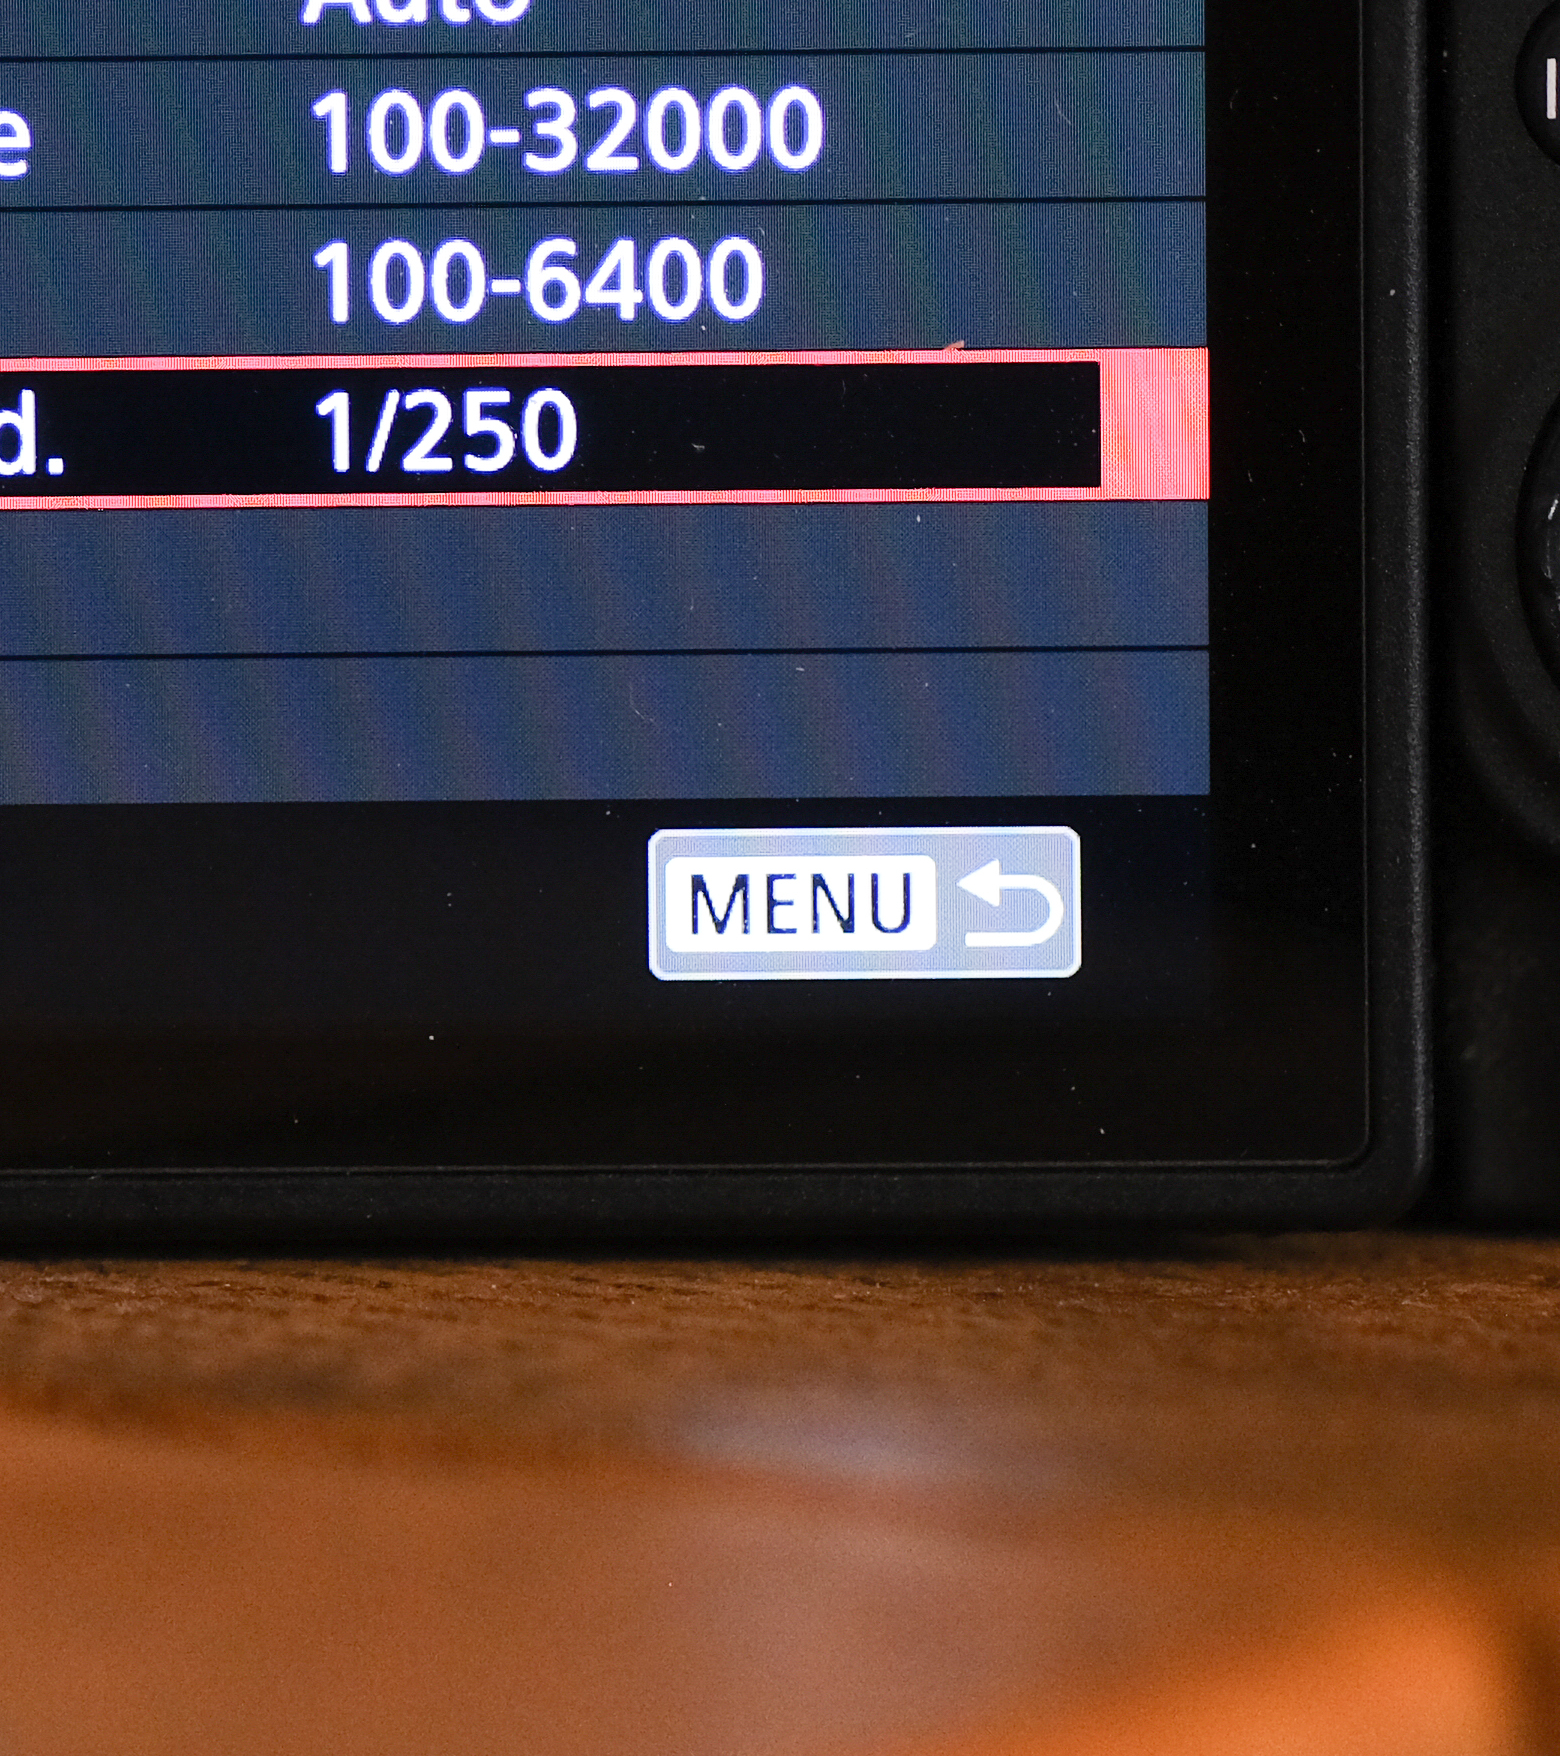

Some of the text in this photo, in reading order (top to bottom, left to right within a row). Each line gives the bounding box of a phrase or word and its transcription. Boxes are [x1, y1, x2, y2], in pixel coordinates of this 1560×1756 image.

[312, 85, 824, 175] 100-32000
[314, 236, 764, 325] 100-6400
[315, 387, 578, 473] 1/250
[691, 872, 911, 935] MENU
